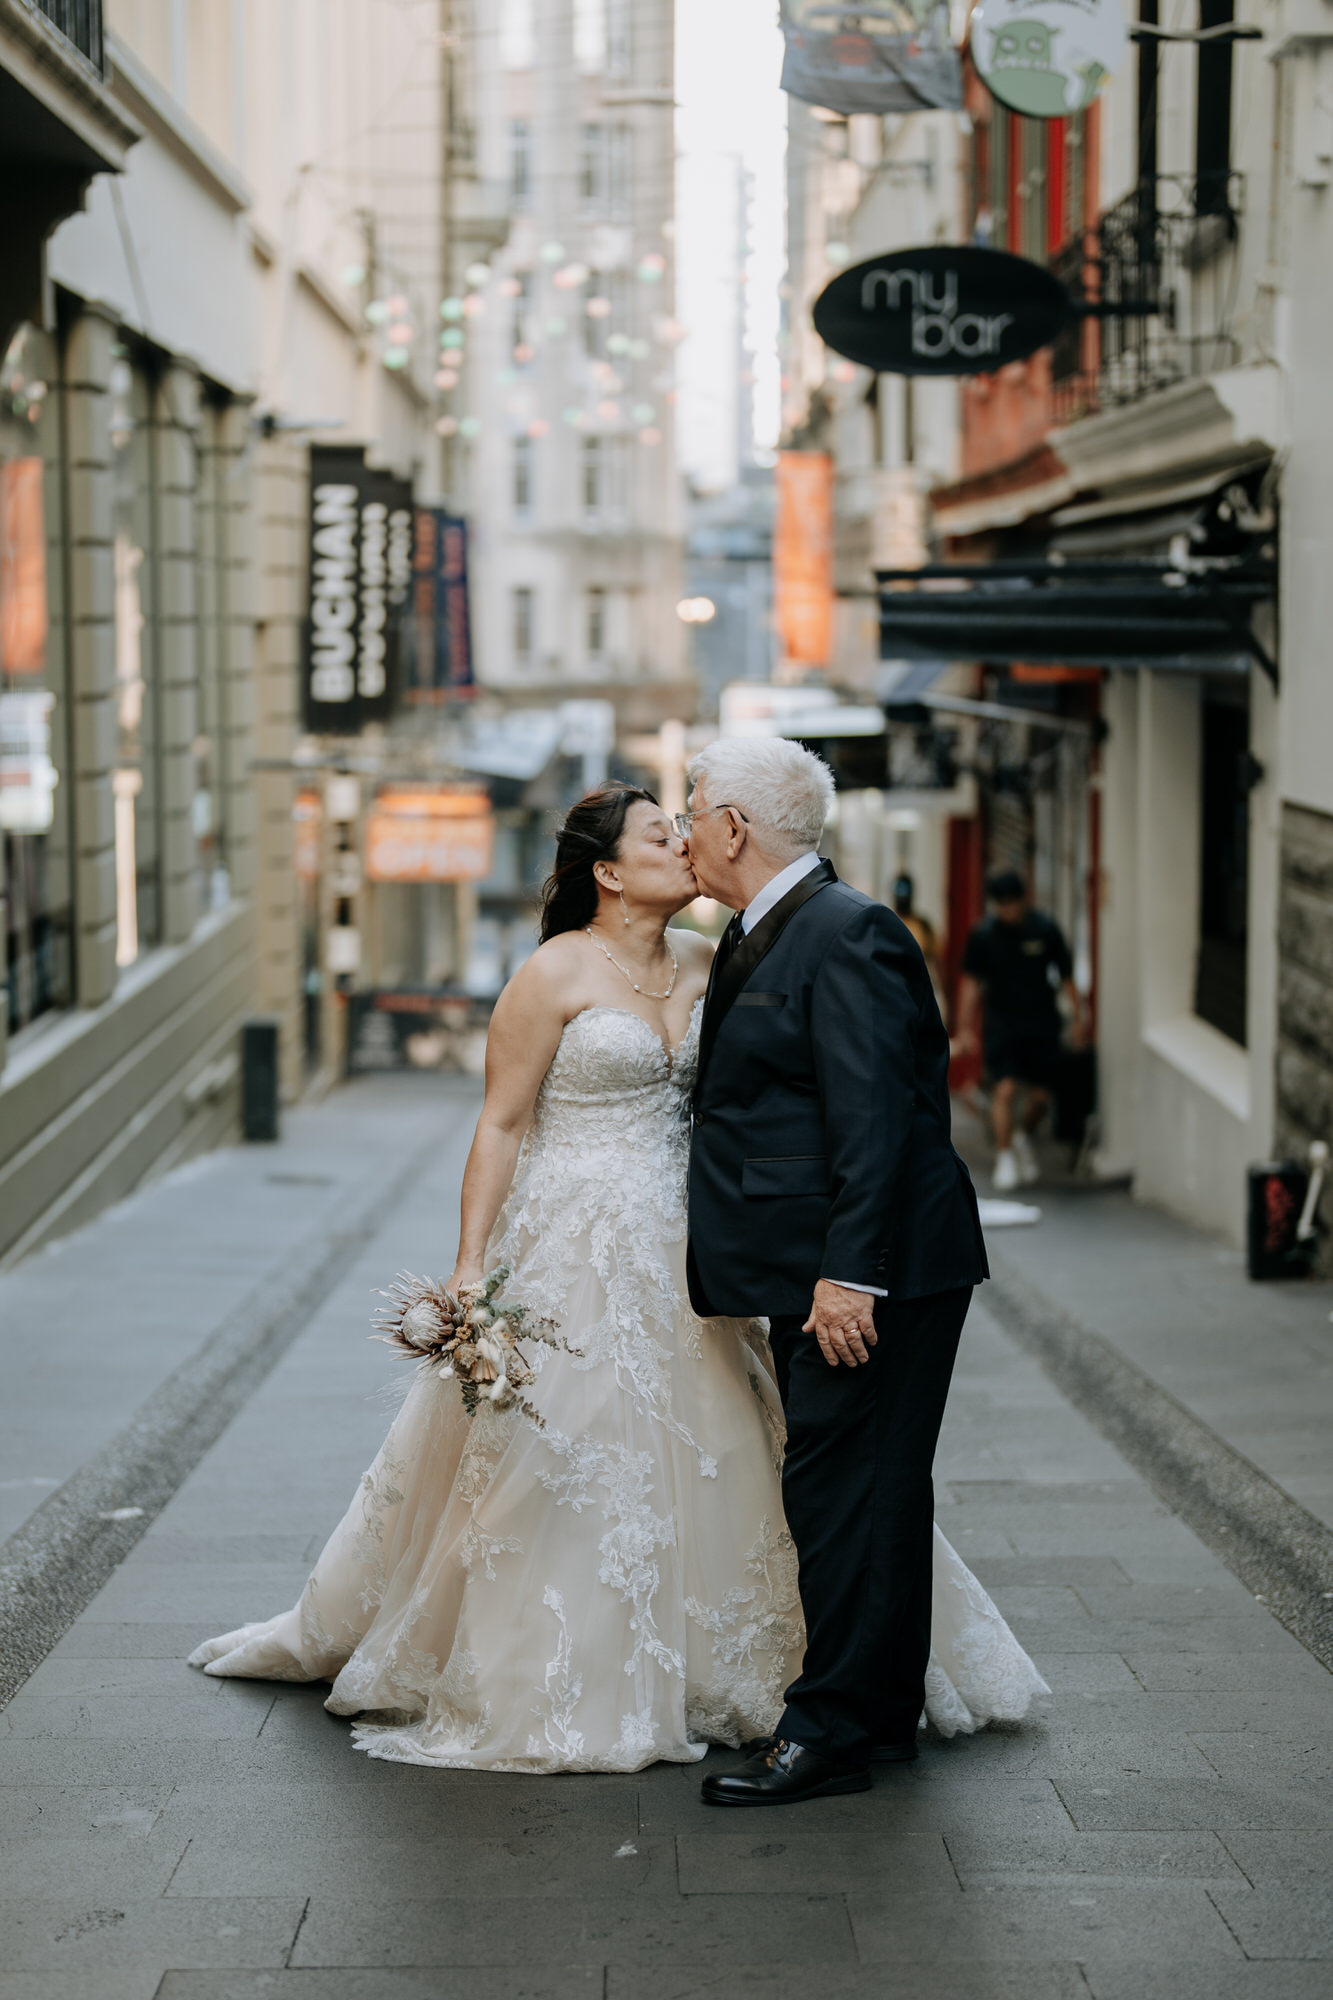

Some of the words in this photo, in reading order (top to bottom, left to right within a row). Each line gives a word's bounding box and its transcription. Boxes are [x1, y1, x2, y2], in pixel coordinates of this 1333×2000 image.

[860, 268, 959, 319] my
[911, 304, 1014, 358] bar
[310, 483, 358, 702] BUCHAN
